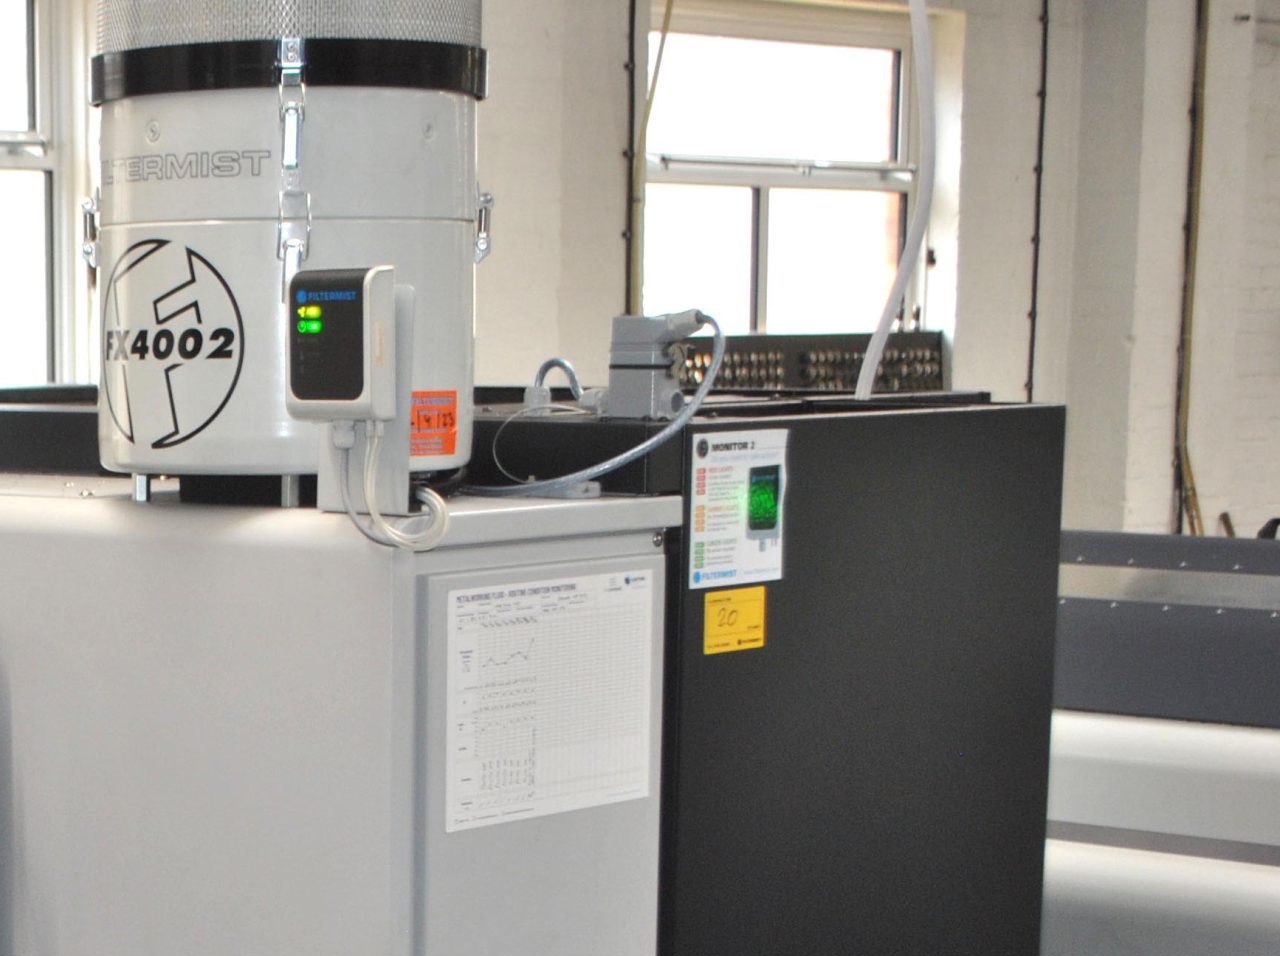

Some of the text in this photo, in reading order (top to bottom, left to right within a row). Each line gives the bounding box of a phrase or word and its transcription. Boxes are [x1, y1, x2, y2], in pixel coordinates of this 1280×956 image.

[308, 290, 357, 301] FILTERMIST
[106, 327, 235, 361] FX4002
[711, 442, 749, 452] MONITOR
